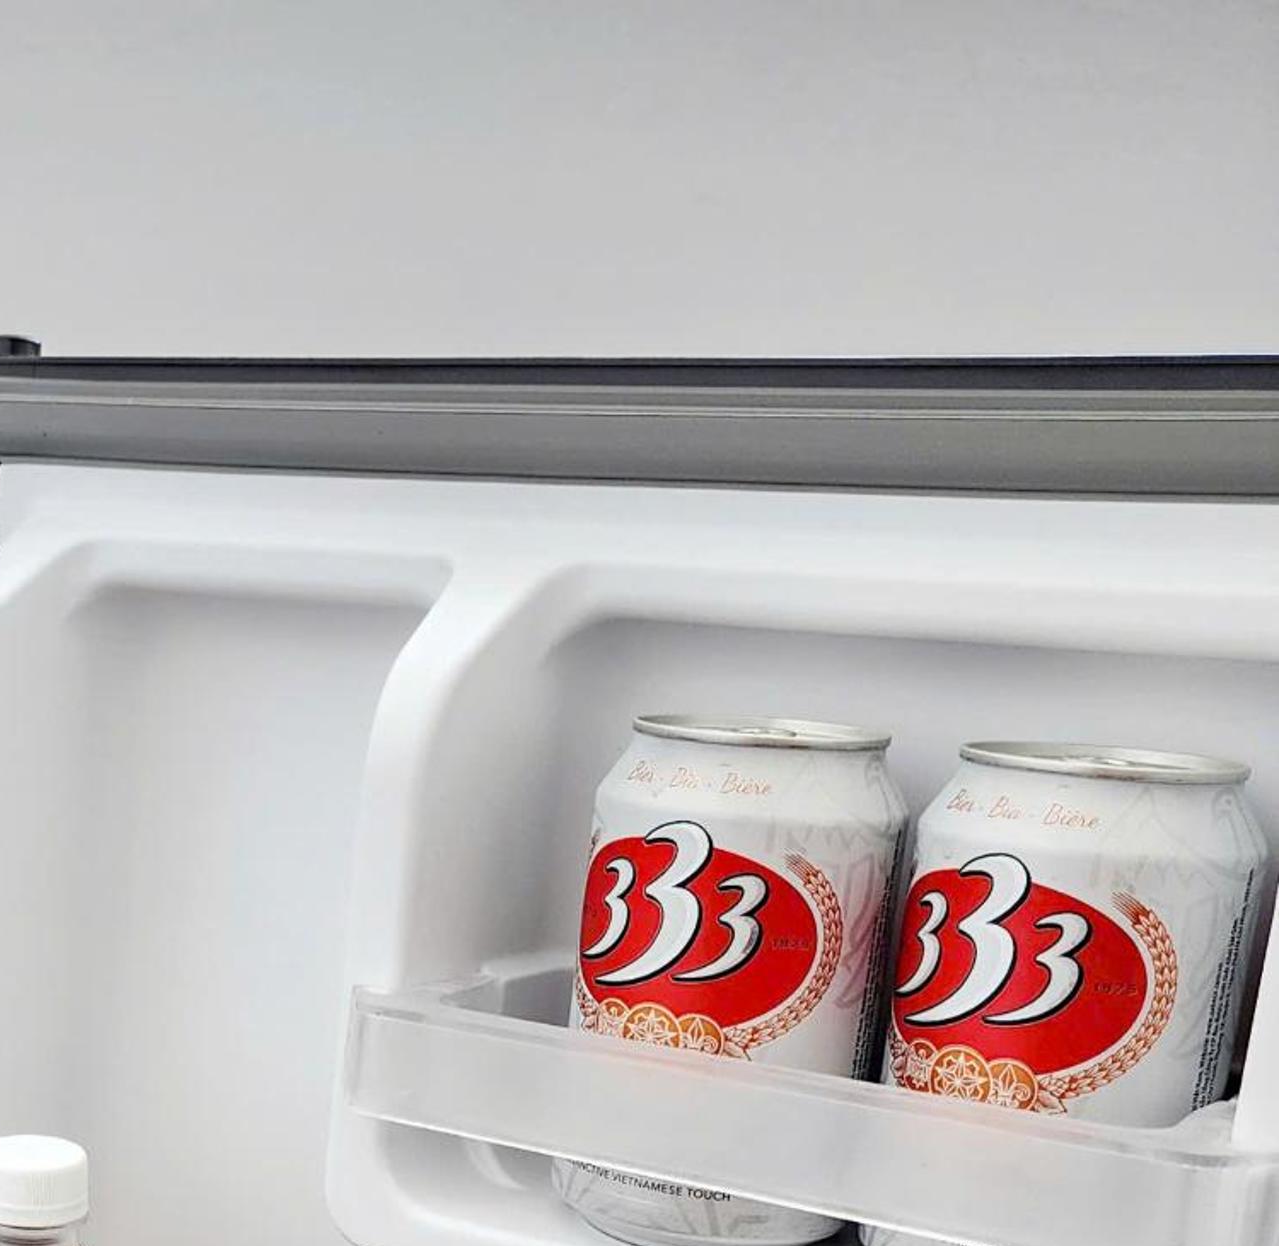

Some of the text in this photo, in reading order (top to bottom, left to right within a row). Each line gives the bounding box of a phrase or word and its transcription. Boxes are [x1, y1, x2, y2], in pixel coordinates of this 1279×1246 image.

[581, 819, 769, 987] 333
[894, 852, 1093, 1027] 333
[686, 1187, 731, 1202] TOUCH
